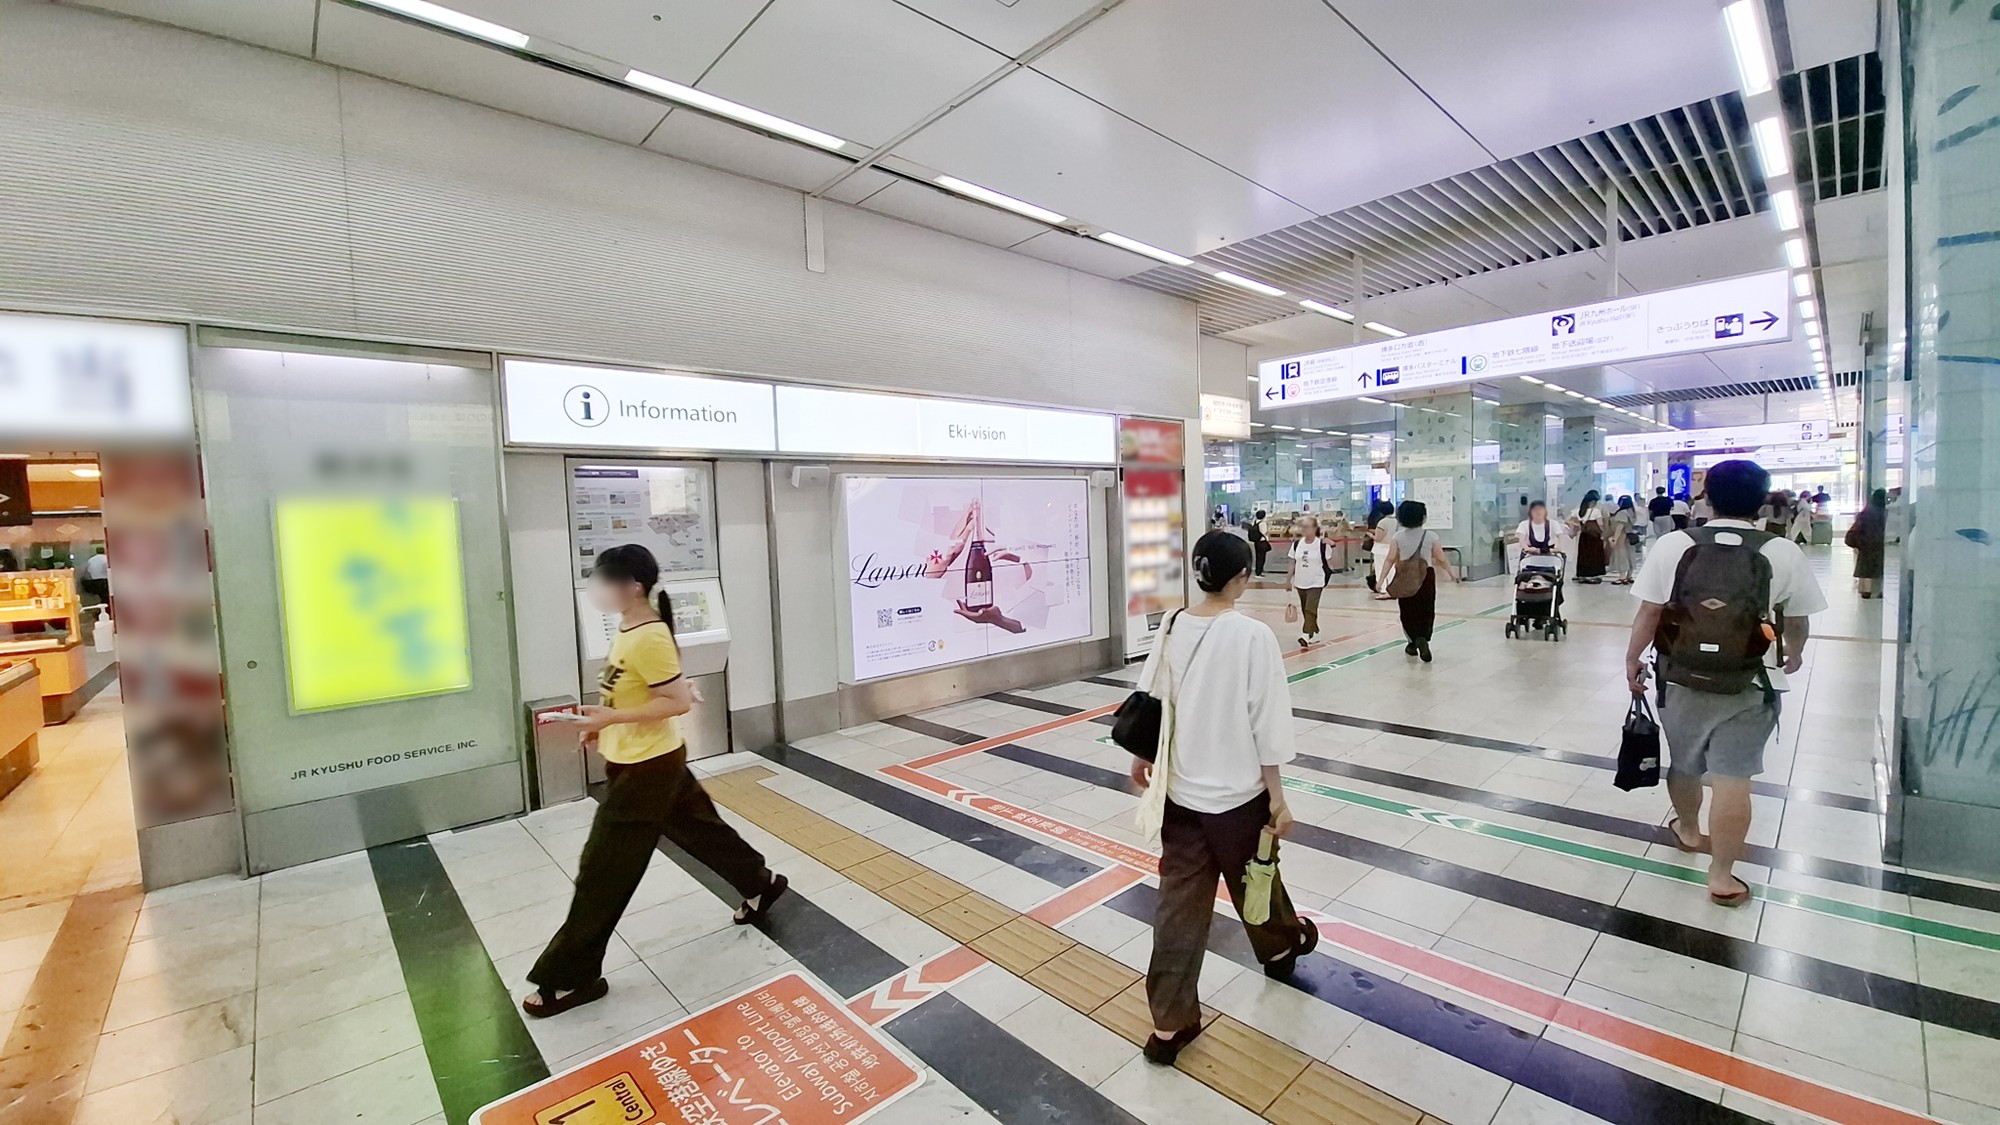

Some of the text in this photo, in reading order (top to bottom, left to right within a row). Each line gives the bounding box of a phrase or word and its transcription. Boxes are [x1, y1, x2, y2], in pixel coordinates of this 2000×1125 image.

[1656, 318, 1710, 334] きっぷうりば
[619, 399, 738, 424] Information
[948, 424, 1006, 441] Eki-vision
[851, 552, 928, 588] Lanson
[290, 770, 307, 781] JR
[311, 760, 364, 777] KYUSHU
[367, 753, 401, 767] FOOD
[457, 739, 479, 750] INC.
[754, 989, 881, 1103] 지하철 공항선 방향 엘리베이터
[792, 995, 881, 1071] 地铁机场线的电梯
[683, 1028, 789, 1125] レベーター
[736, 1002, 853, 1115] Subway Airport Line
[737, 1035, 803, 1102] Elevator to
[604, 1078, 644, 1121] Central
